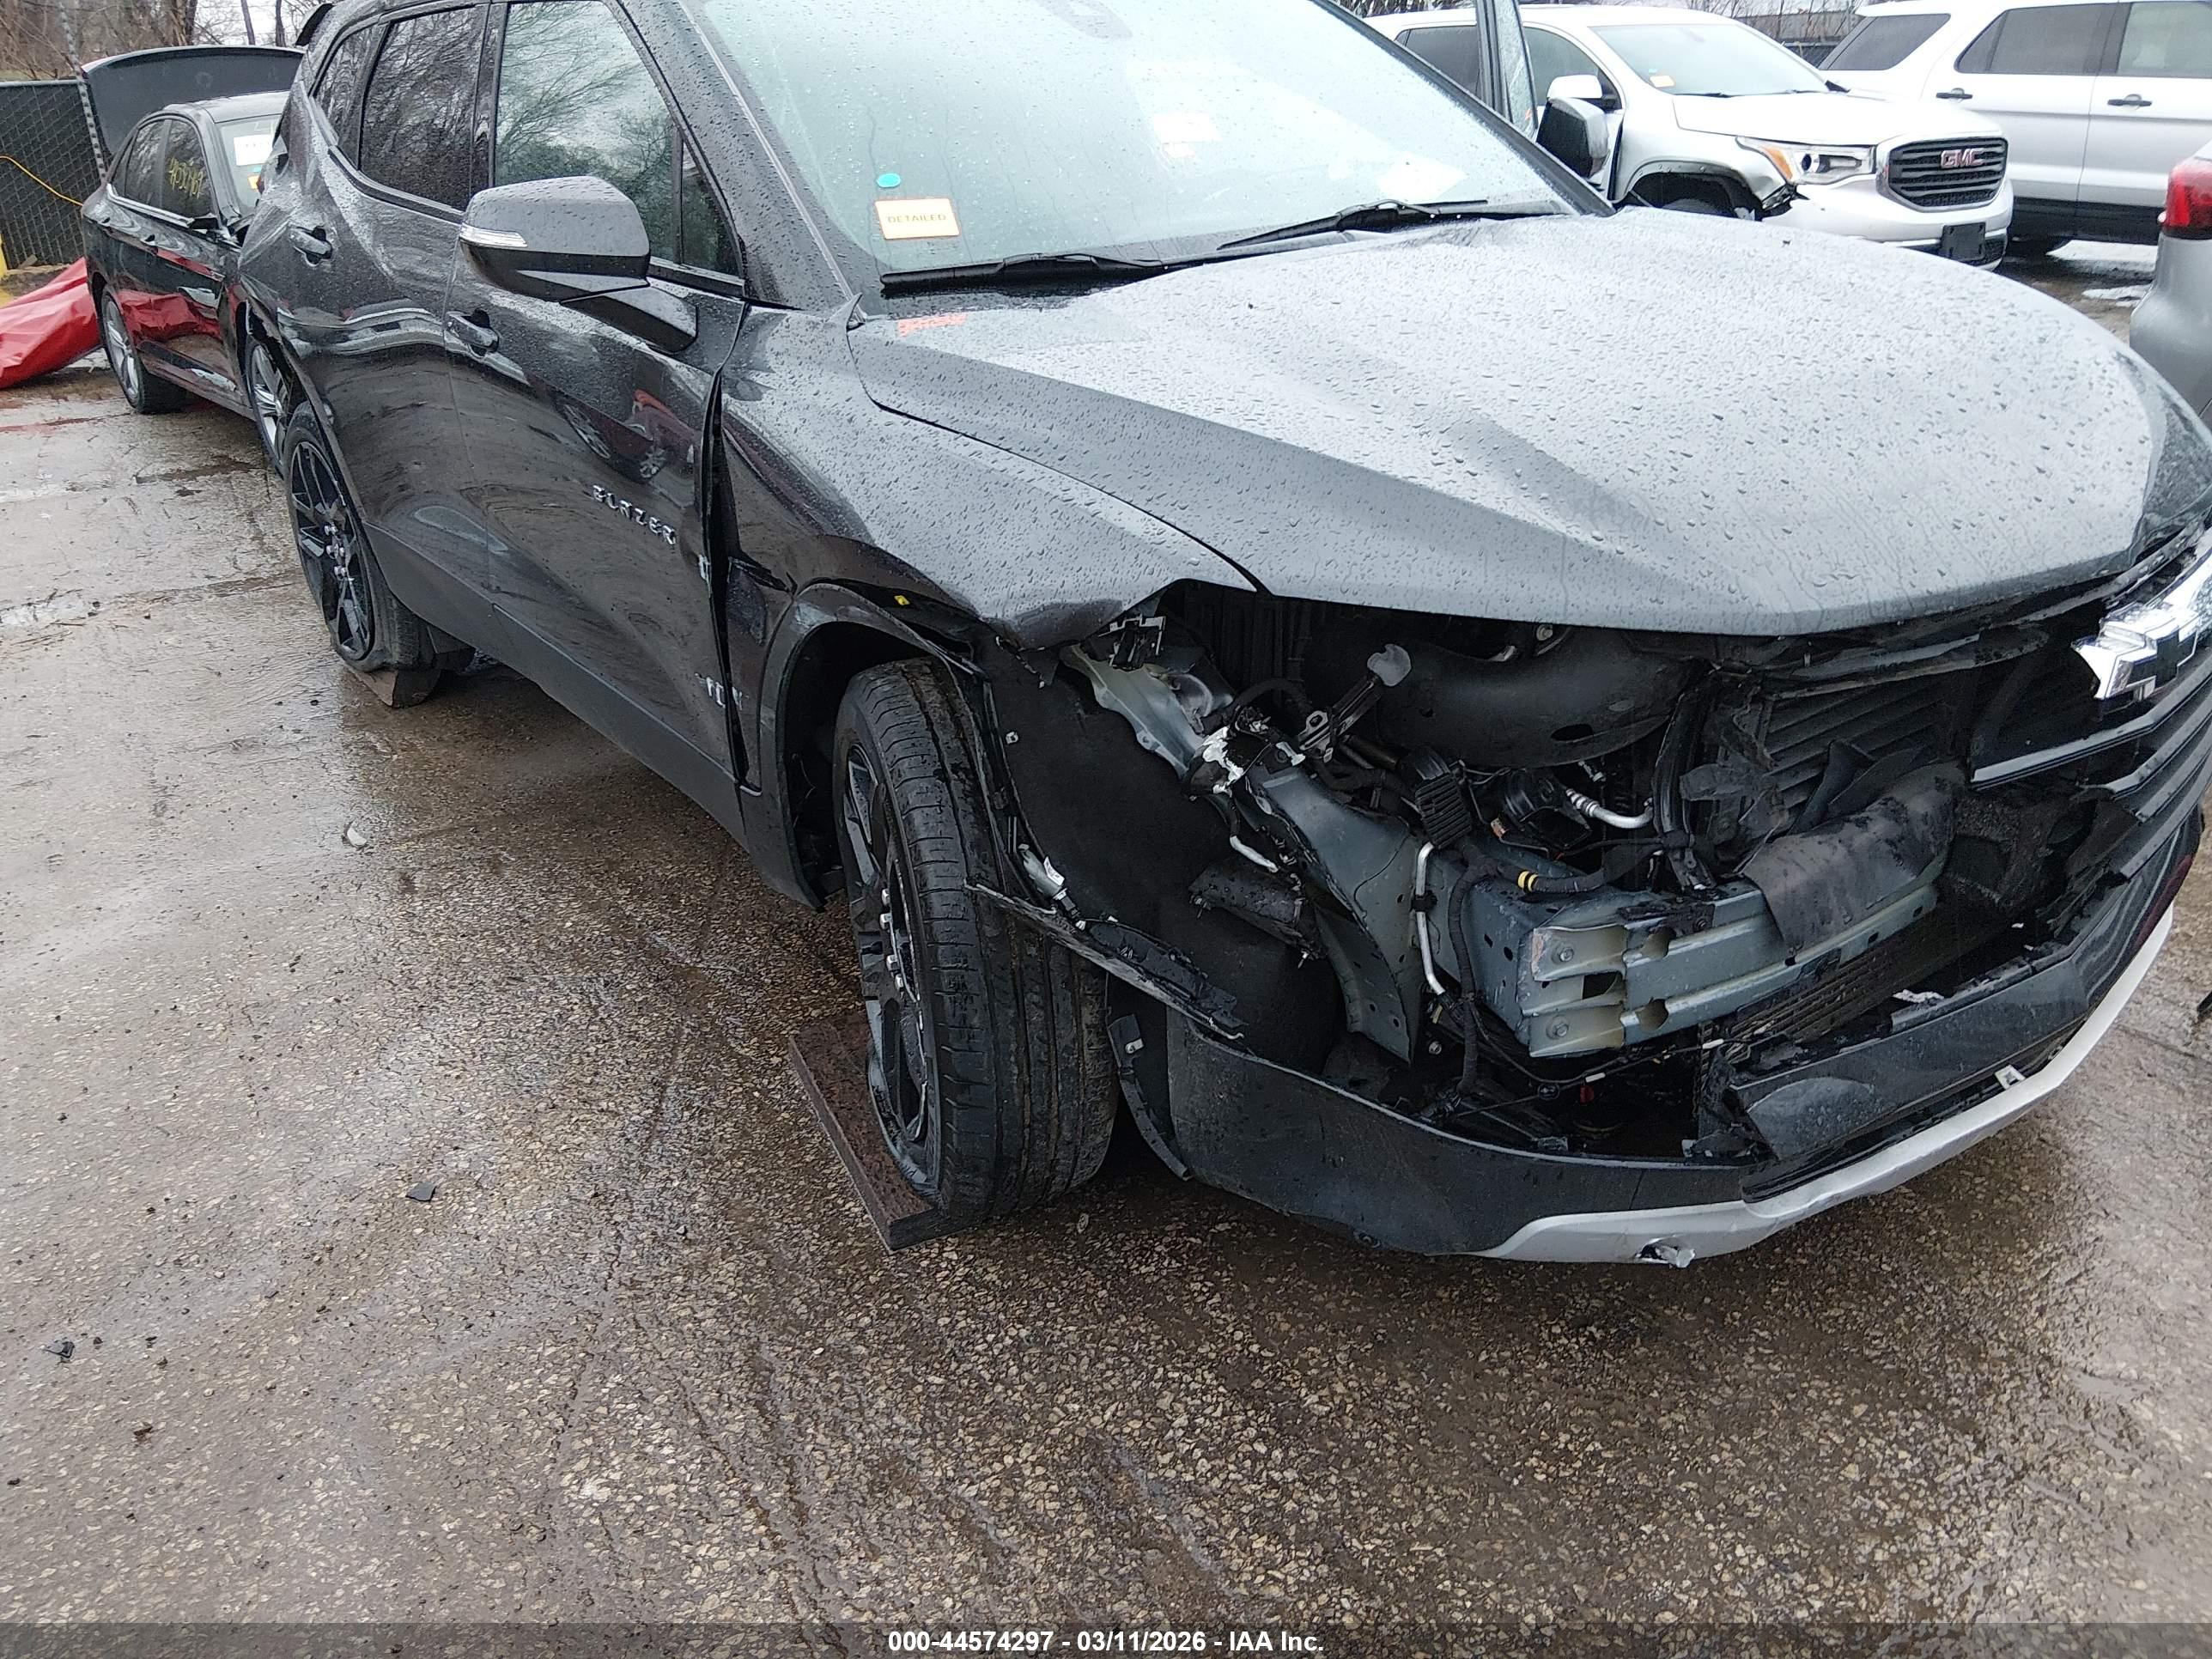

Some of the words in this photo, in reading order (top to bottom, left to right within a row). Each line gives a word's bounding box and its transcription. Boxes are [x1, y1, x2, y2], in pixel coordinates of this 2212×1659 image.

[1941, 148, 1984, 168] GMC
[887, 214, 946, 223] DETAILED
[592, 484, 677, 545] BLAZER
